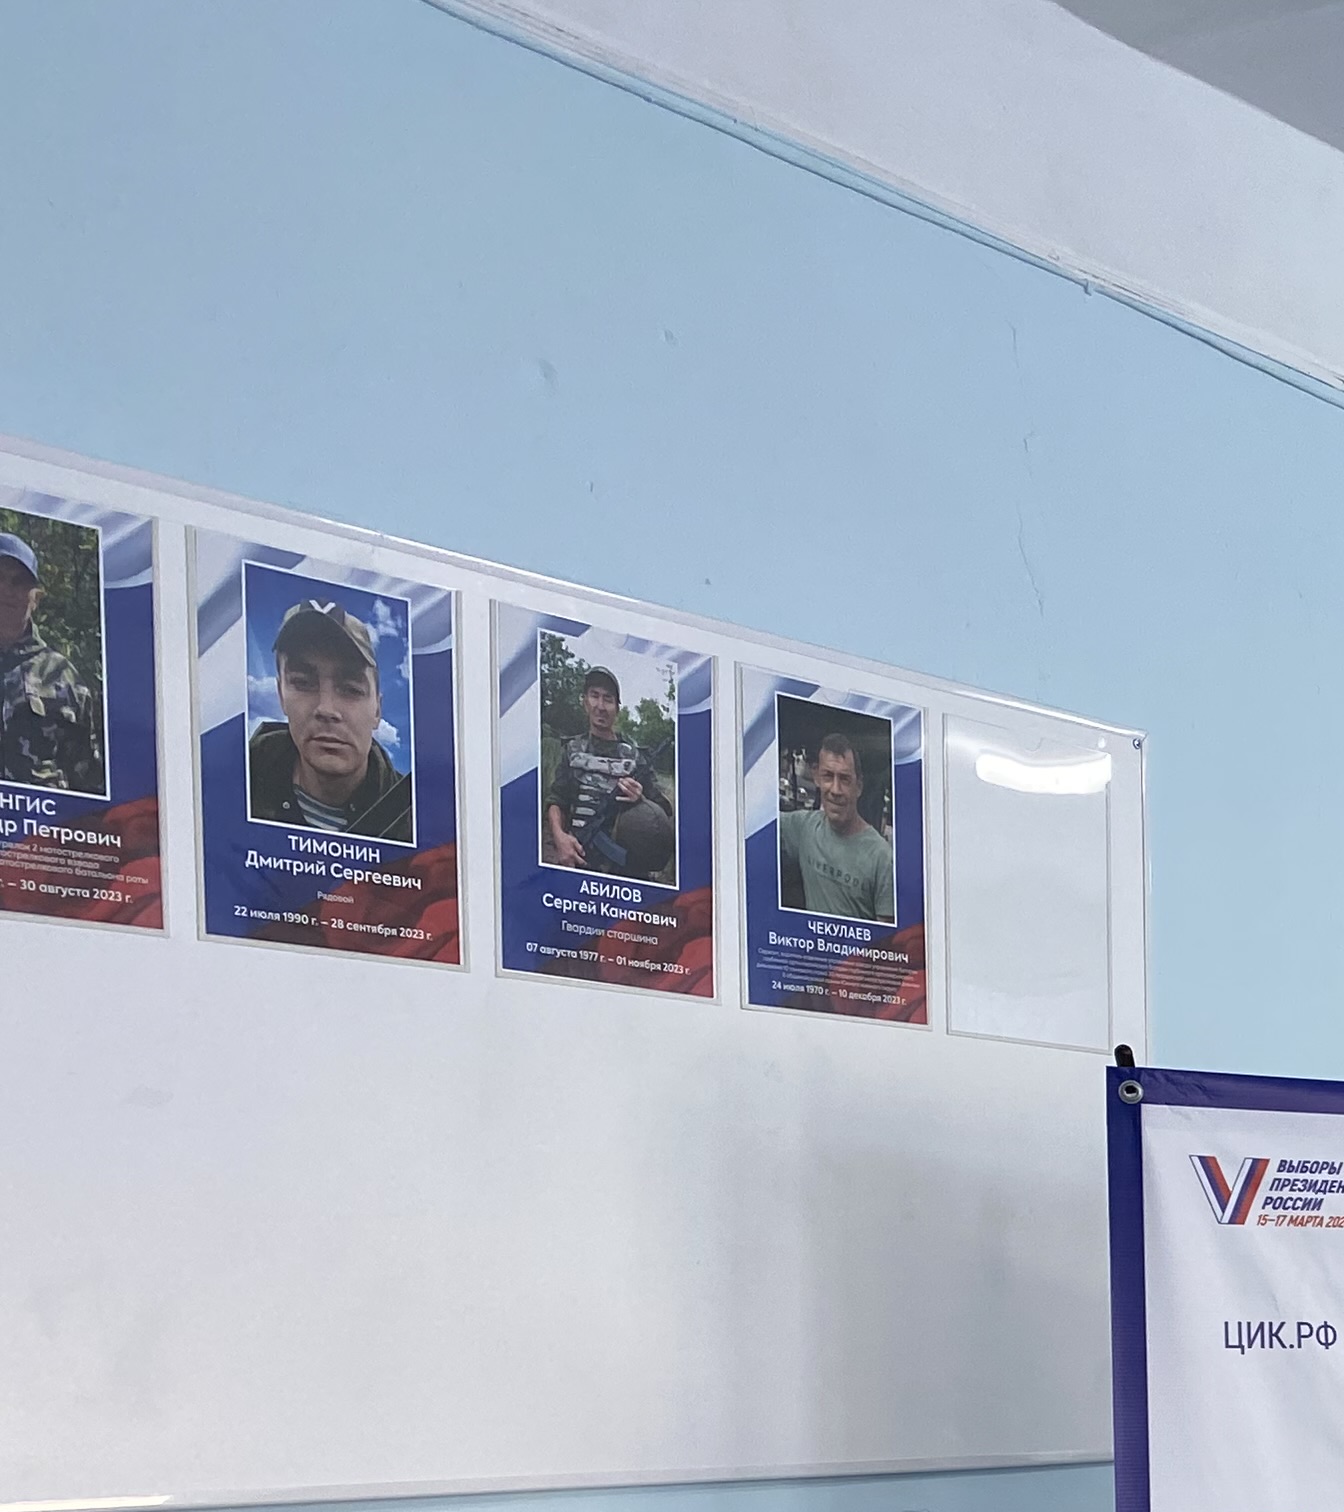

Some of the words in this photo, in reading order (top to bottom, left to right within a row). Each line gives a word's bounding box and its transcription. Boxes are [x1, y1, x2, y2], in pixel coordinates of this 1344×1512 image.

[23, 819, 122, 848] Петрович
[288, 835, 381, 864] ТИМОНИН
[245, 850, 326, 876] Дмитрий
[330, 863, 422, 890] Сергеевич
[20, 879, 36, 891] 30
[39, 885, 90, 898] августа
[93, 889, 122, 902] 2023
[125, 894, 133, 903] г.
[317, 891, 354, 904] Рядовой
[580, 880, 642, 903] АБИЛОВ
[543, 893, 597, 914] Сергей
[600, 902, 677, 928] Канатович
[234, 906, 248, 917] 22
[250, 909, 280, 921] июля
[283, 912, 308, 925] 1990
[311, 918, 319, 926] г.
[331, 918, 344, 929] 28
[347, 922, 397, 938] сентября
[399, 927, 424, 940] 2023
[426, 932, 433, 941] г.
[561, 920, 605, 936] Гвардии
[607, 930, 658, 945] старшина
[808, 920, 872, 941] ЧЕКУЛАЕВ
[526, 942, 537, 952] 07
[540, 946, 578, 959] августа
[579, 951, 599, 961] 1977
[600, 955, 607, 963] г.
[616, 955, 627, 966] 01
[628, 959, 661, 971] ноября
[663, 963, 684, 974] 2023
[685, 967, 691, 975] г.
[769, 932, 814, 952] Виктор
[817, 940, 909, 963] Владимирович
[772, 981, 782, 990] 24
[783, 983, 805, 992] июля
[806, 985, 823, 995] 1970
[839, 989, 847, 998] 10
[849, 991, 881, 1003] декабря
[882, 995, 901, 1004] 2023
[1277, 1160, 1343, 1175] ВЫБОРЫ
[1262, 1197, 1324, 1212] РОССИИ
[1286, 1215, 1324, 1228] МАРТА
[1224, 1321, 1337, 1355] ЦИК.РФ
